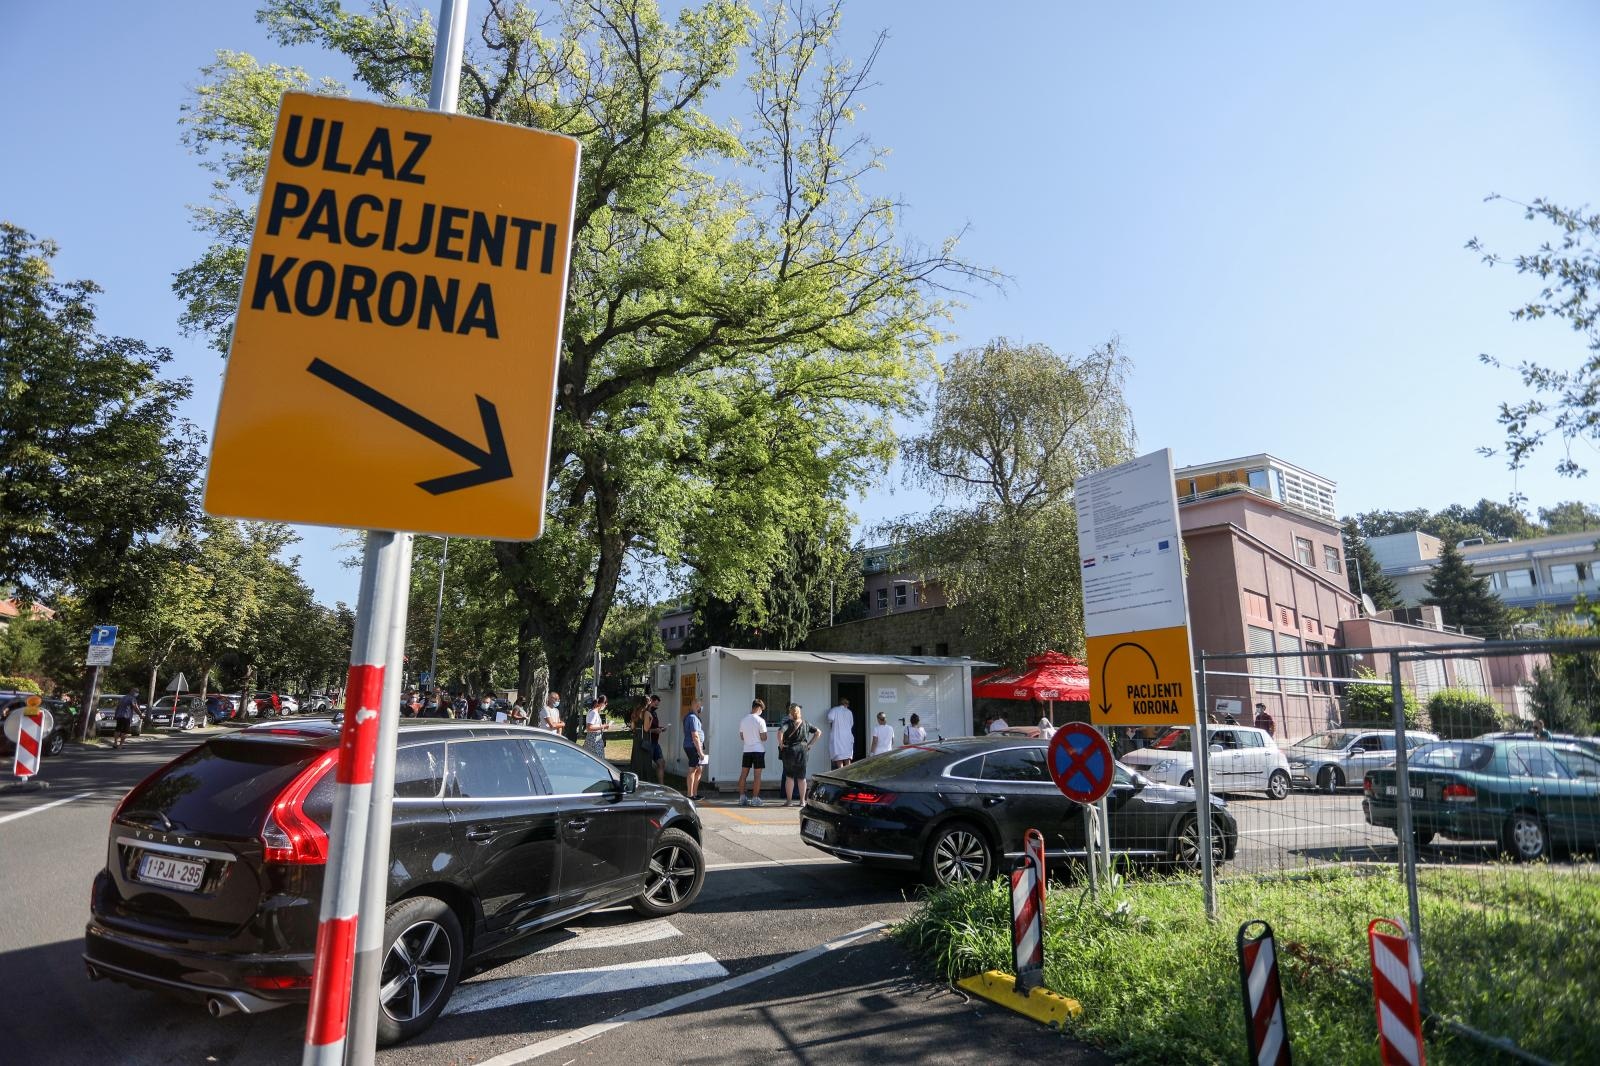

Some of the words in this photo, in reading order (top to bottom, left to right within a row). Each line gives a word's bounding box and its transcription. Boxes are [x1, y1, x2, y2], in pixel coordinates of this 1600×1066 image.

[282, 114, 432, 185] ULAZ
[265, 181, 557, 275] PACIJENTI
[250, 253, 500, 340] KORONA
[98, 629, 110, 641] P
[1127, 682, 1183, 699] PACIJENTI
[1133, 699, 1179, 715] KORONA
[135, 830, 201, 846] VOLVO
